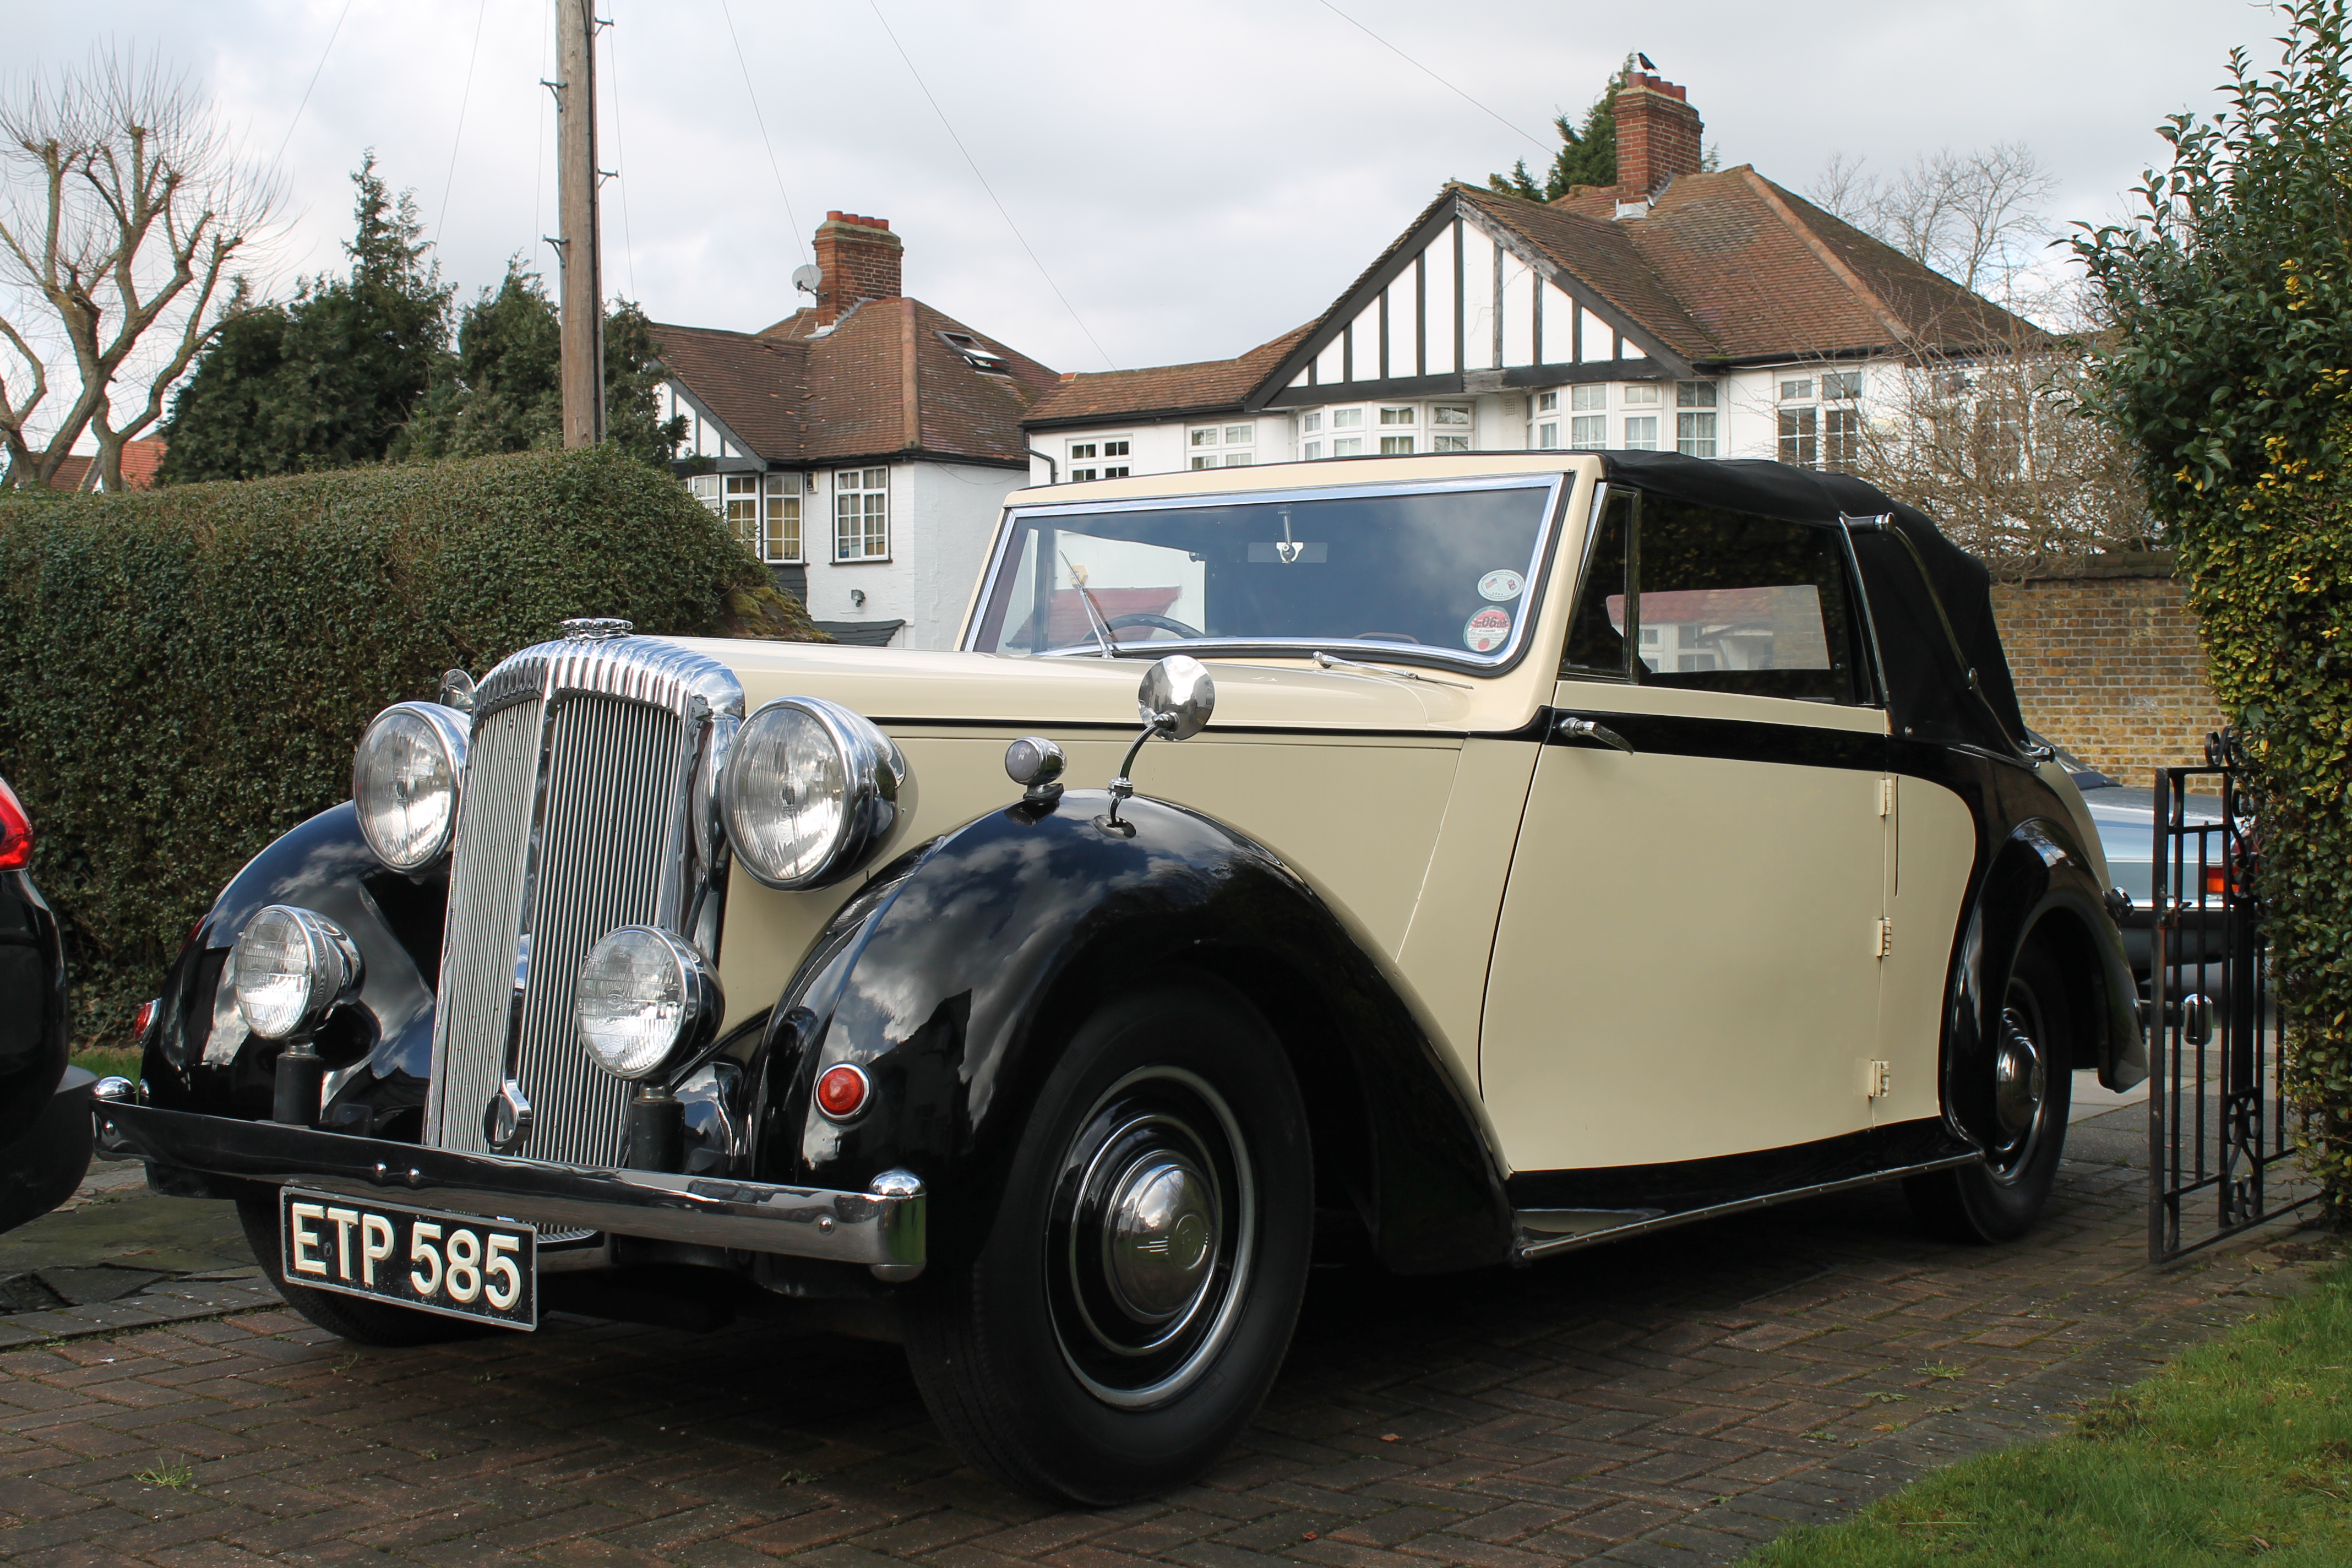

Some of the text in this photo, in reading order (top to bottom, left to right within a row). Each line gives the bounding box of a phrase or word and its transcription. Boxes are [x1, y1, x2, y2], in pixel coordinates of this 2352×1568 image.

[1482, 616, 1497, 628] 06
[292, 1202, 521, 1311] ETP 585
